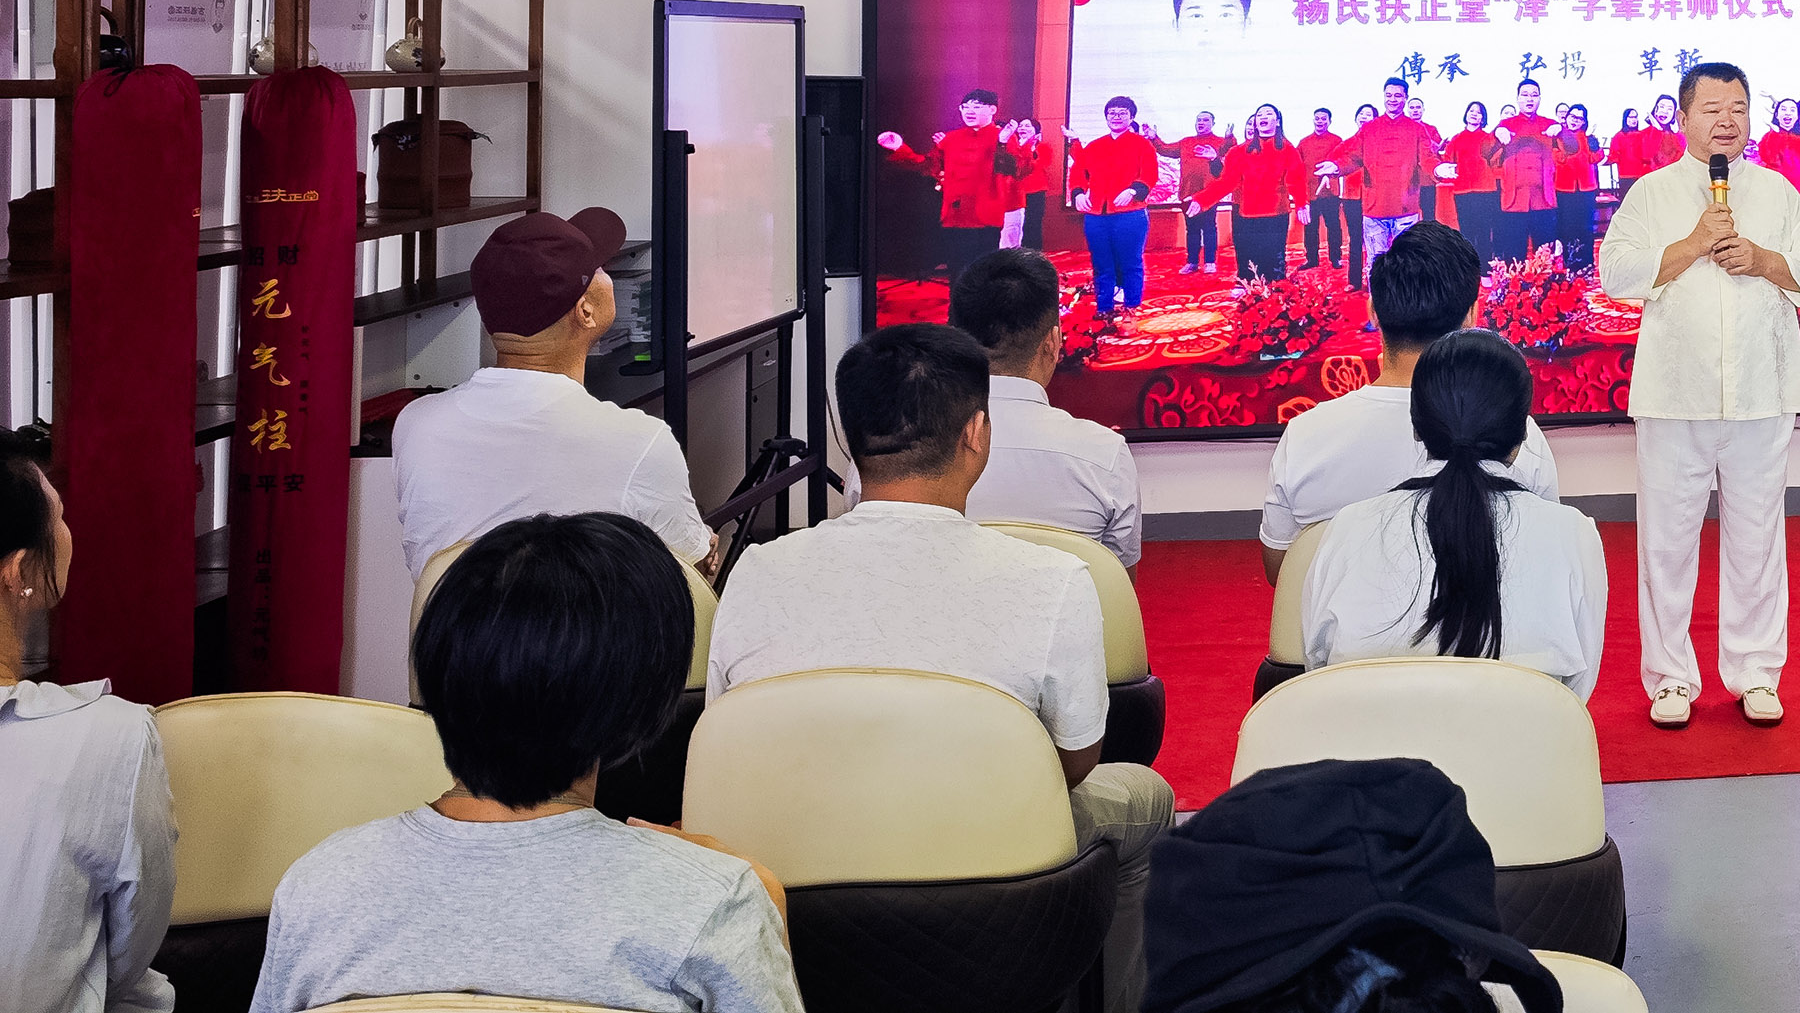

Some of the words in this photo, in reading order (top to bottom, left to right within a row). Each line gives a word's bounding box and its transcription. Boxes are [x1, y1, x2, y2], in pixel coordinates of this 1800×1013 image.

[1395, 51, 1469, 85] 傳承
[1519, 50, 1587, 81] 弘揚
[247, 278, 292, 454] 元气柱
